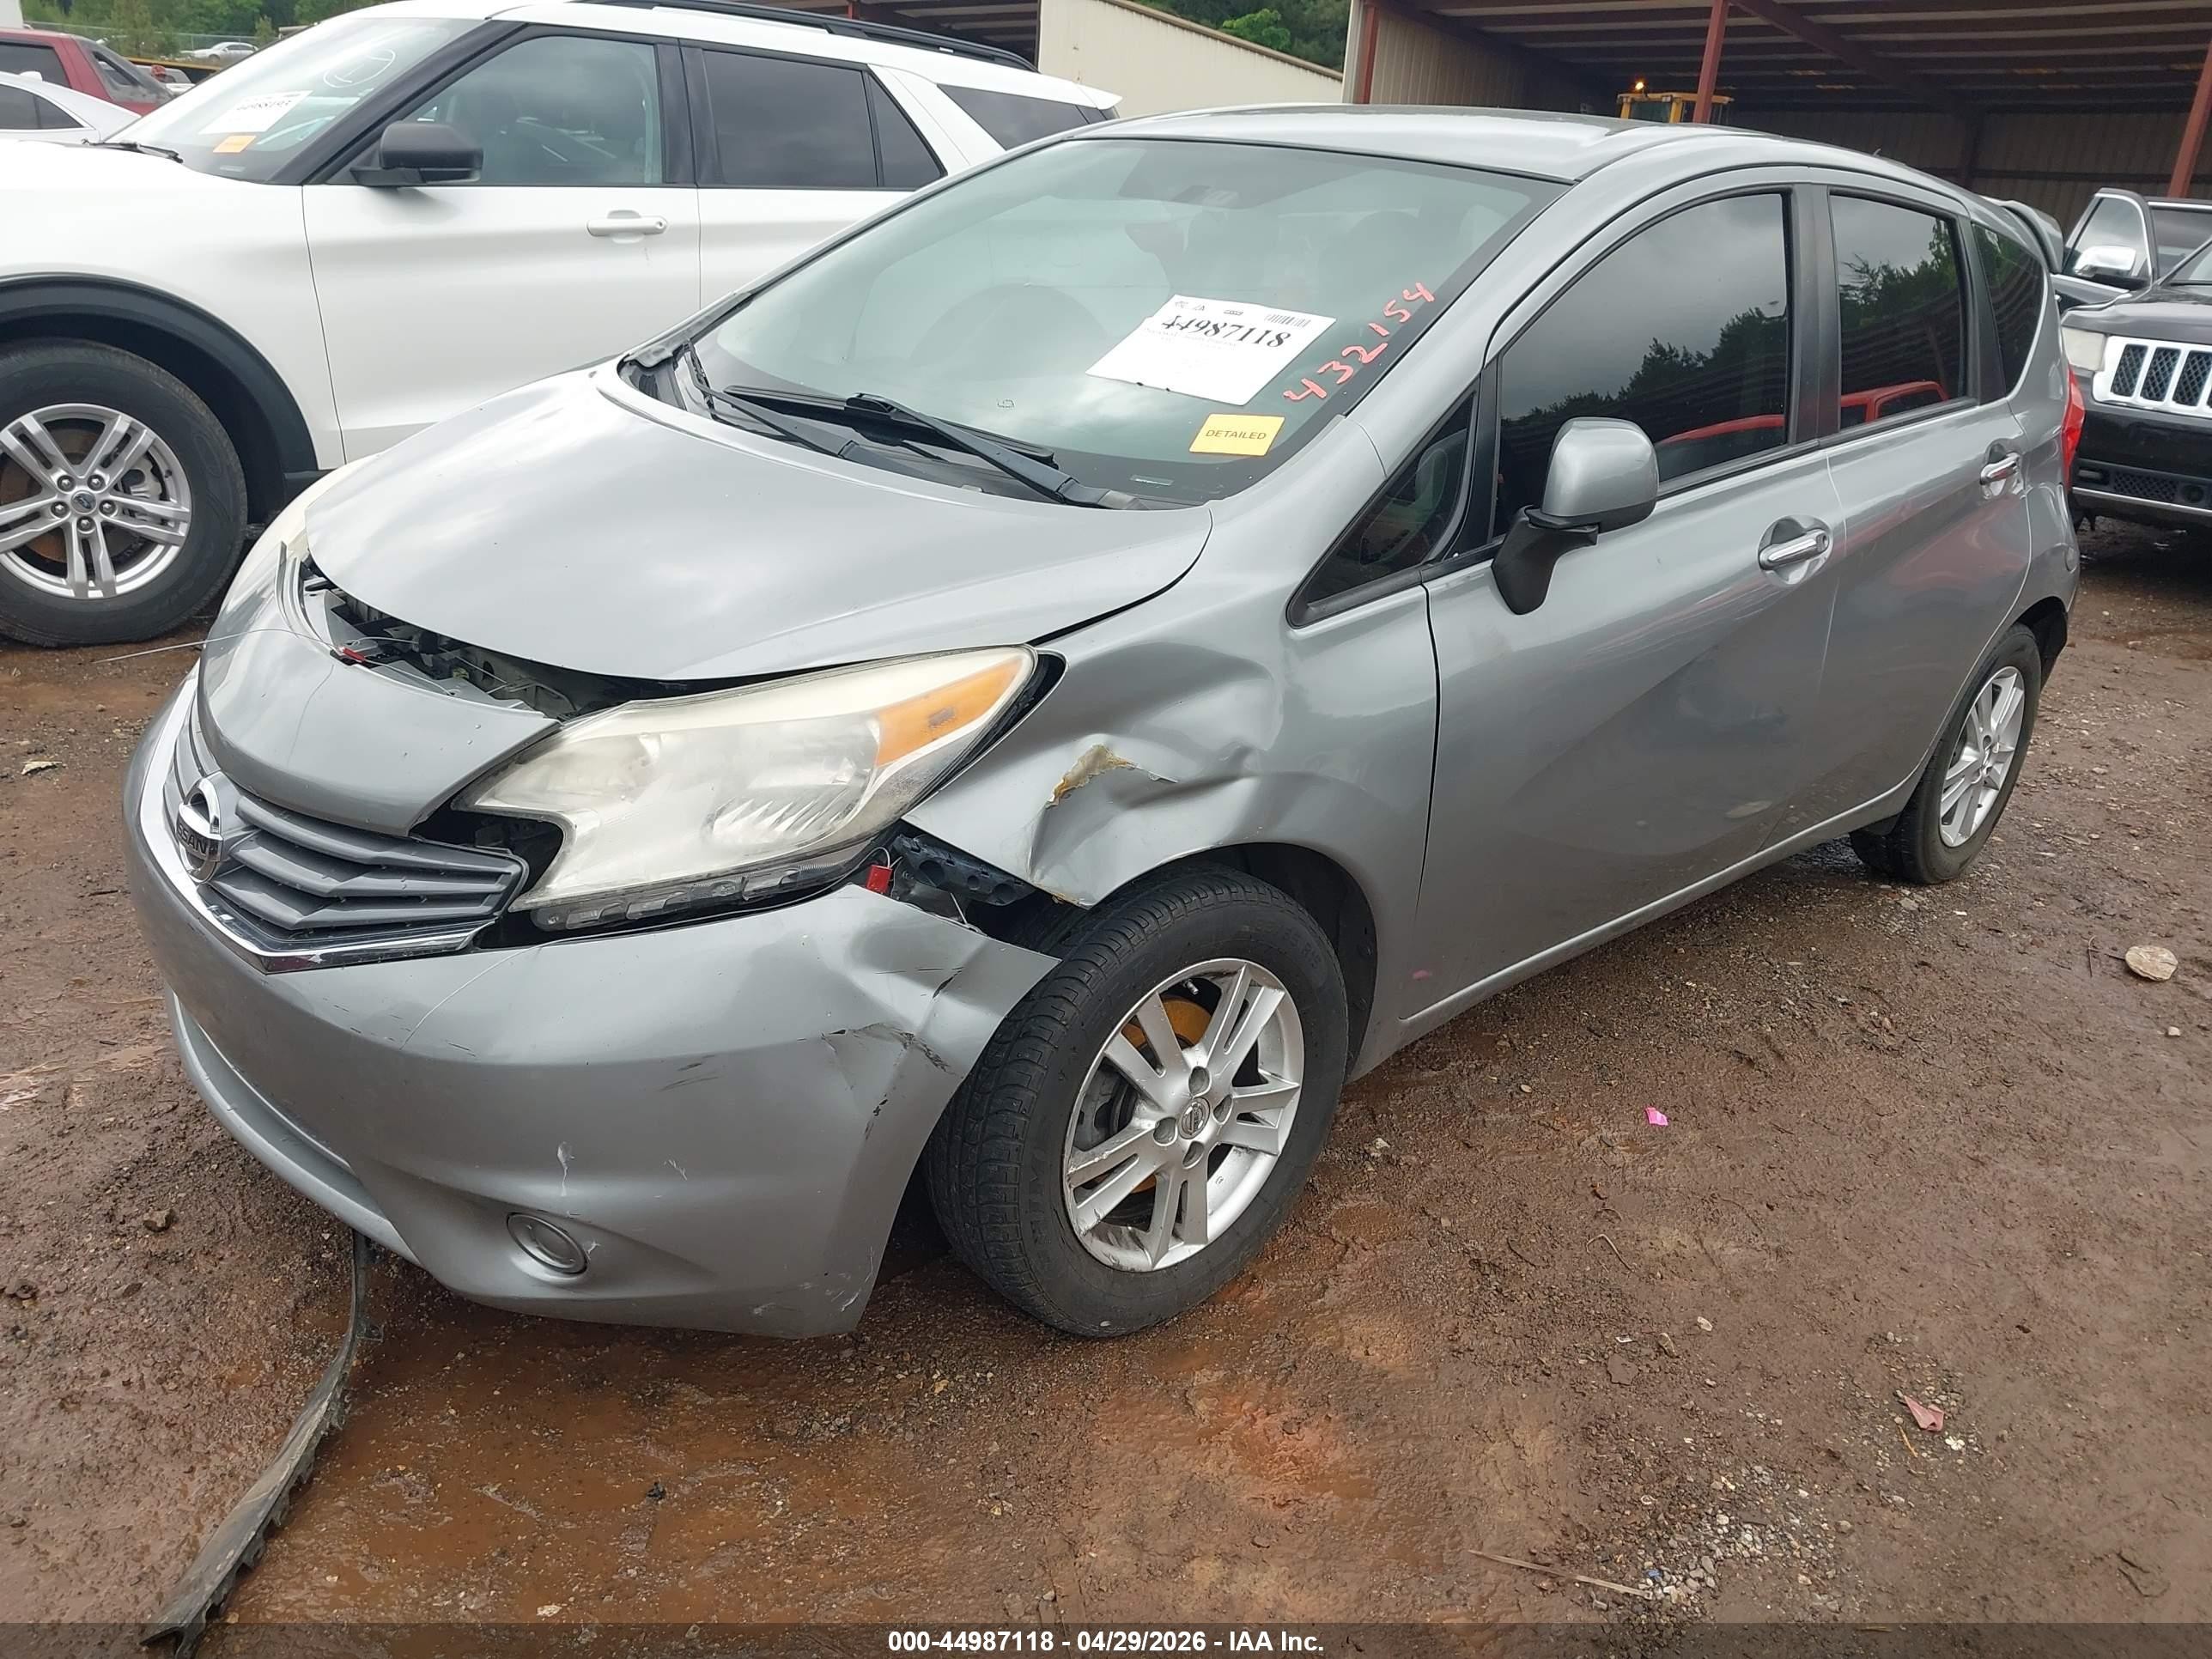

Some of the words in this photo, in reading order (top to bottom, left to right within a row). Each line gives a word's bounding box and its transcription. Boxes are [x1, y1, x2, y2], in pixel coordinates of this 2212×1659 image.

[1162, 315, 1291, 348] 44987118
[1283, 282, 1435, 401] 432154
[1205, 429, 1267, 441] DETAILED
